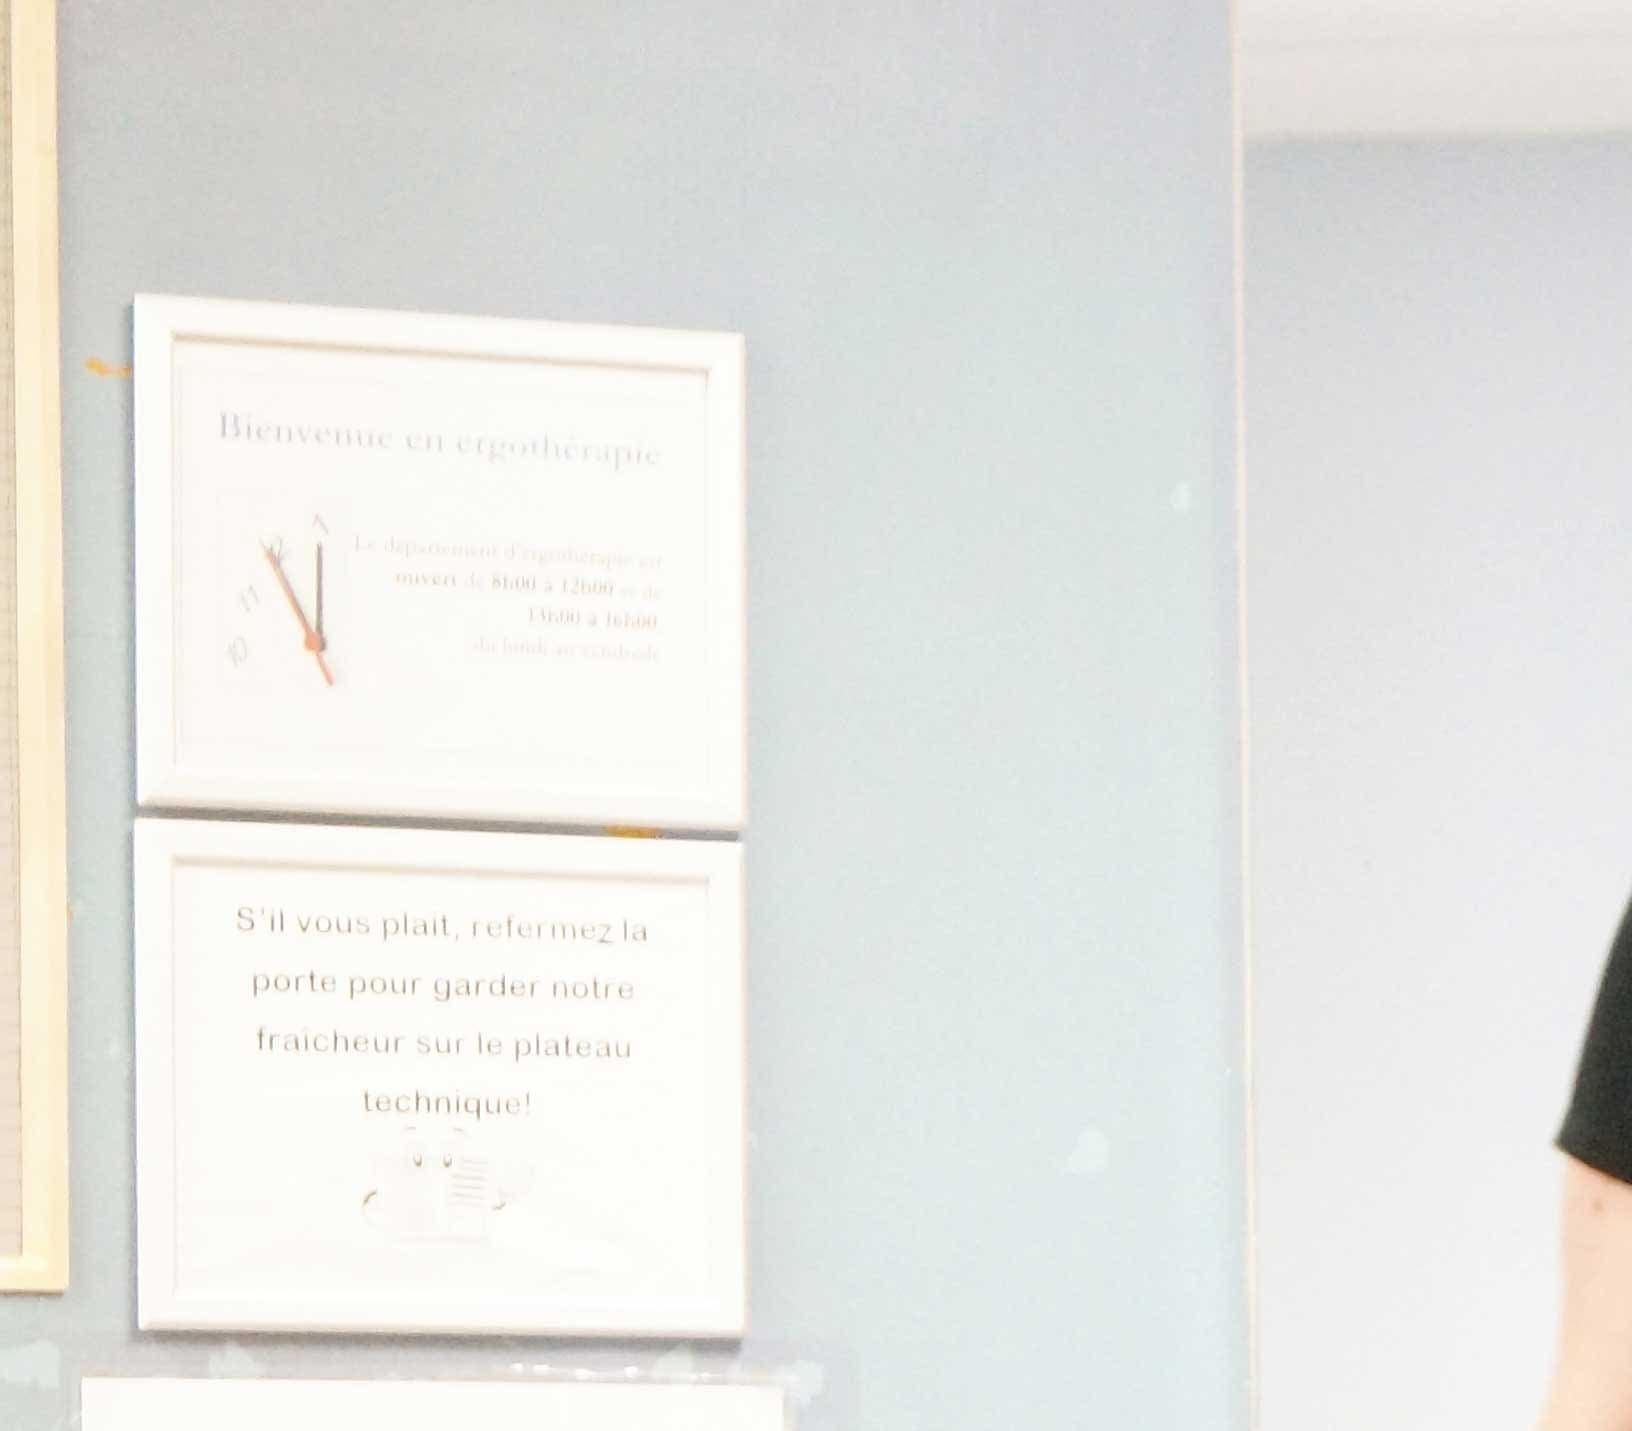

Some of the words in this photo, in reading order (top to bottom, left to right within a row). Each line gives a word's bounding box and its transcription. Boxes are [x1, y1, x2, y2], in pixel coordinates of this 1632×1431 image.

[218, 410, 392, 448] Bienvenue
[405, 431, 444, 454] en
[235, 905, 285, 934] S'il
[295, 913, 370, 935] vous
[471, 914, 614, 945] refermez
[622, 917, 648, 943] la
[251, 970, 337, 998] porte
[348, 973, 422, 1001] pour
[432, 975, 541, 1004] garder
[552, 977, 634, 1001] notre
[416, 1034, 466, 1057] sur
[477, 1032, 503, 1057] le
[513, 1031, 632, 1063] plateau
[362, 1088, 533, 1121] technique!
